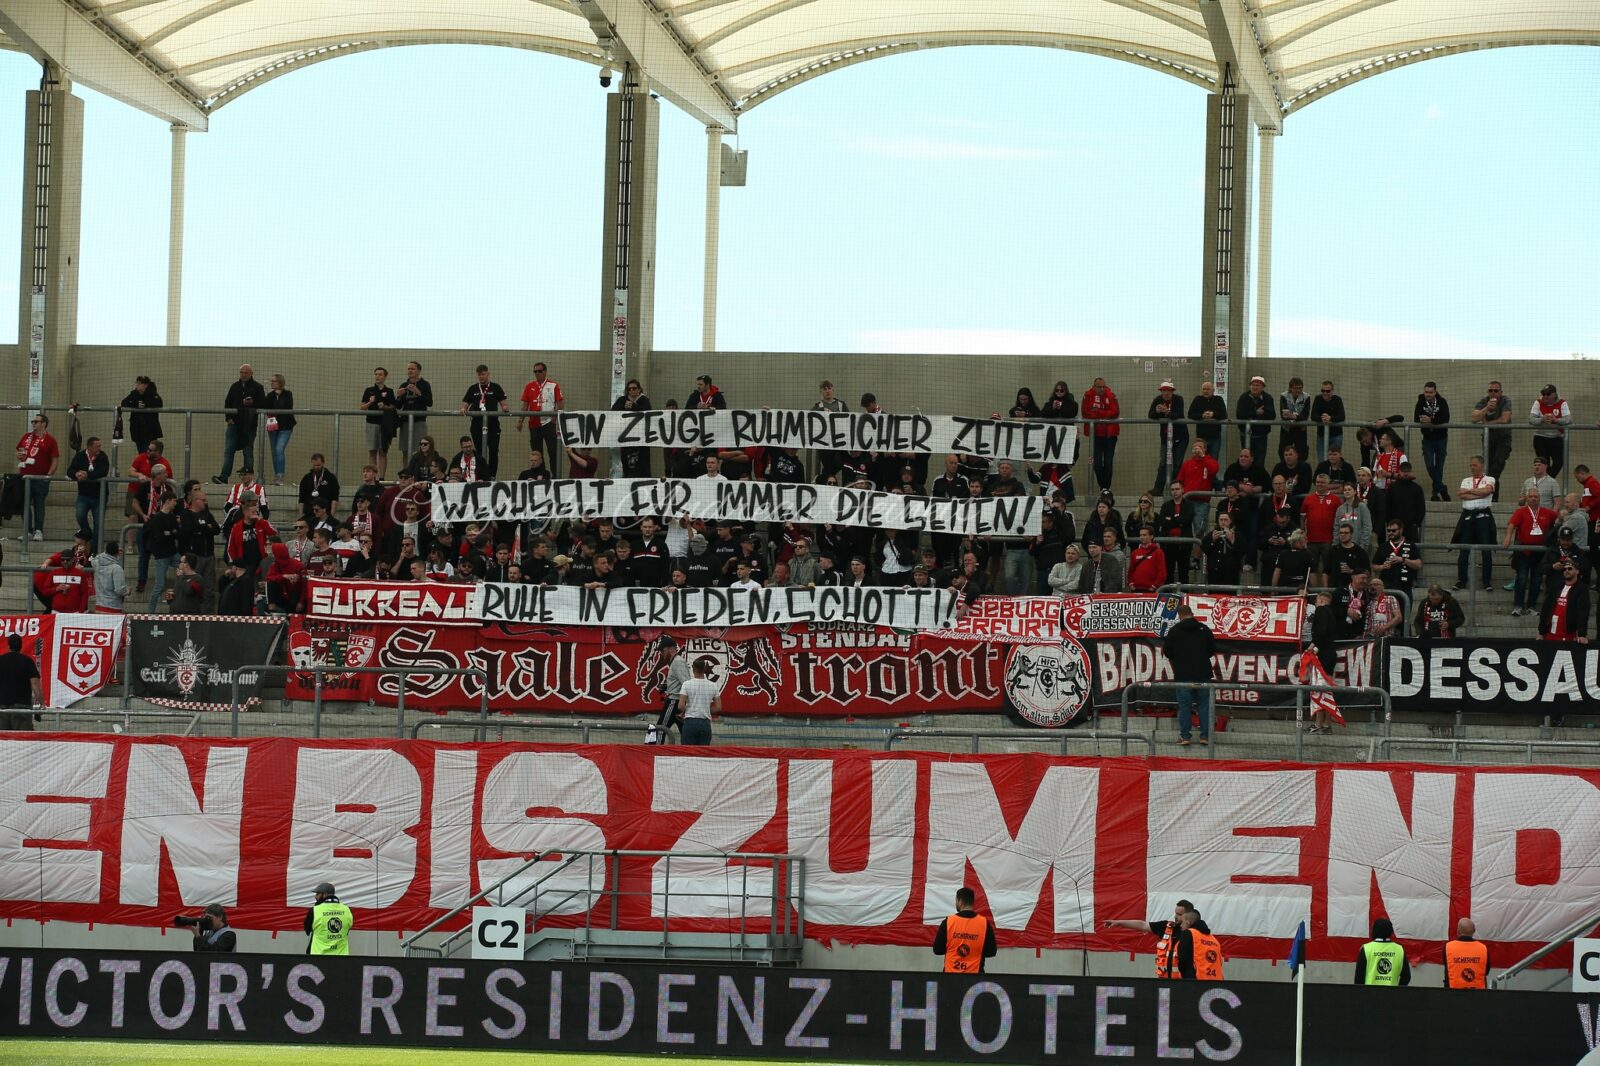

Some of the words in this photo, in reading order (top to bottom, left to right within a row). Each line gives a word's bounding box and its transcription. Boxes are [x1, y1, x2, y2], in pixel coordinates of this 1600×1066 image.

[561, 412, 605, 446] EIN
[617, 410, 716, 446] ZEUGE
[731, 410, 932, 452] RUHMREICHER
[951, 416, 1068, 460] ZEITEN
[438, 478, 615, 520] WECHSELT
[717, 482, 818, 521] IMMER
[836, 487, 889, 527] DIE
[903, 495, 1037, 535] SEITEN!
[482, 584, 558, 621] RUHE
[579, 587, 610, 622] IN
[627, 588, 781, 623] FRIEDEN,
[788, 586, 960, 627] SCHOTT!!
[1091, 601, 1155, 617] SEKTION
[1081, 617, 1162, 630] WEISSENFELS
[64, 630, 110, 646] HFC
[349, 637, 370, 646] HFC
[692, 639, 722, 651] HFC
[378, 627, 630, 705] Saale
[1216, 689, 1259, 702] alle
[286, 747, 609, 916] BIS
[649, 755, 1100, 934] ZUM
[478, 919, 519, 950] C2
[953, 961, 967, 970] 26
[1206, 968, 1216, 977] 24
